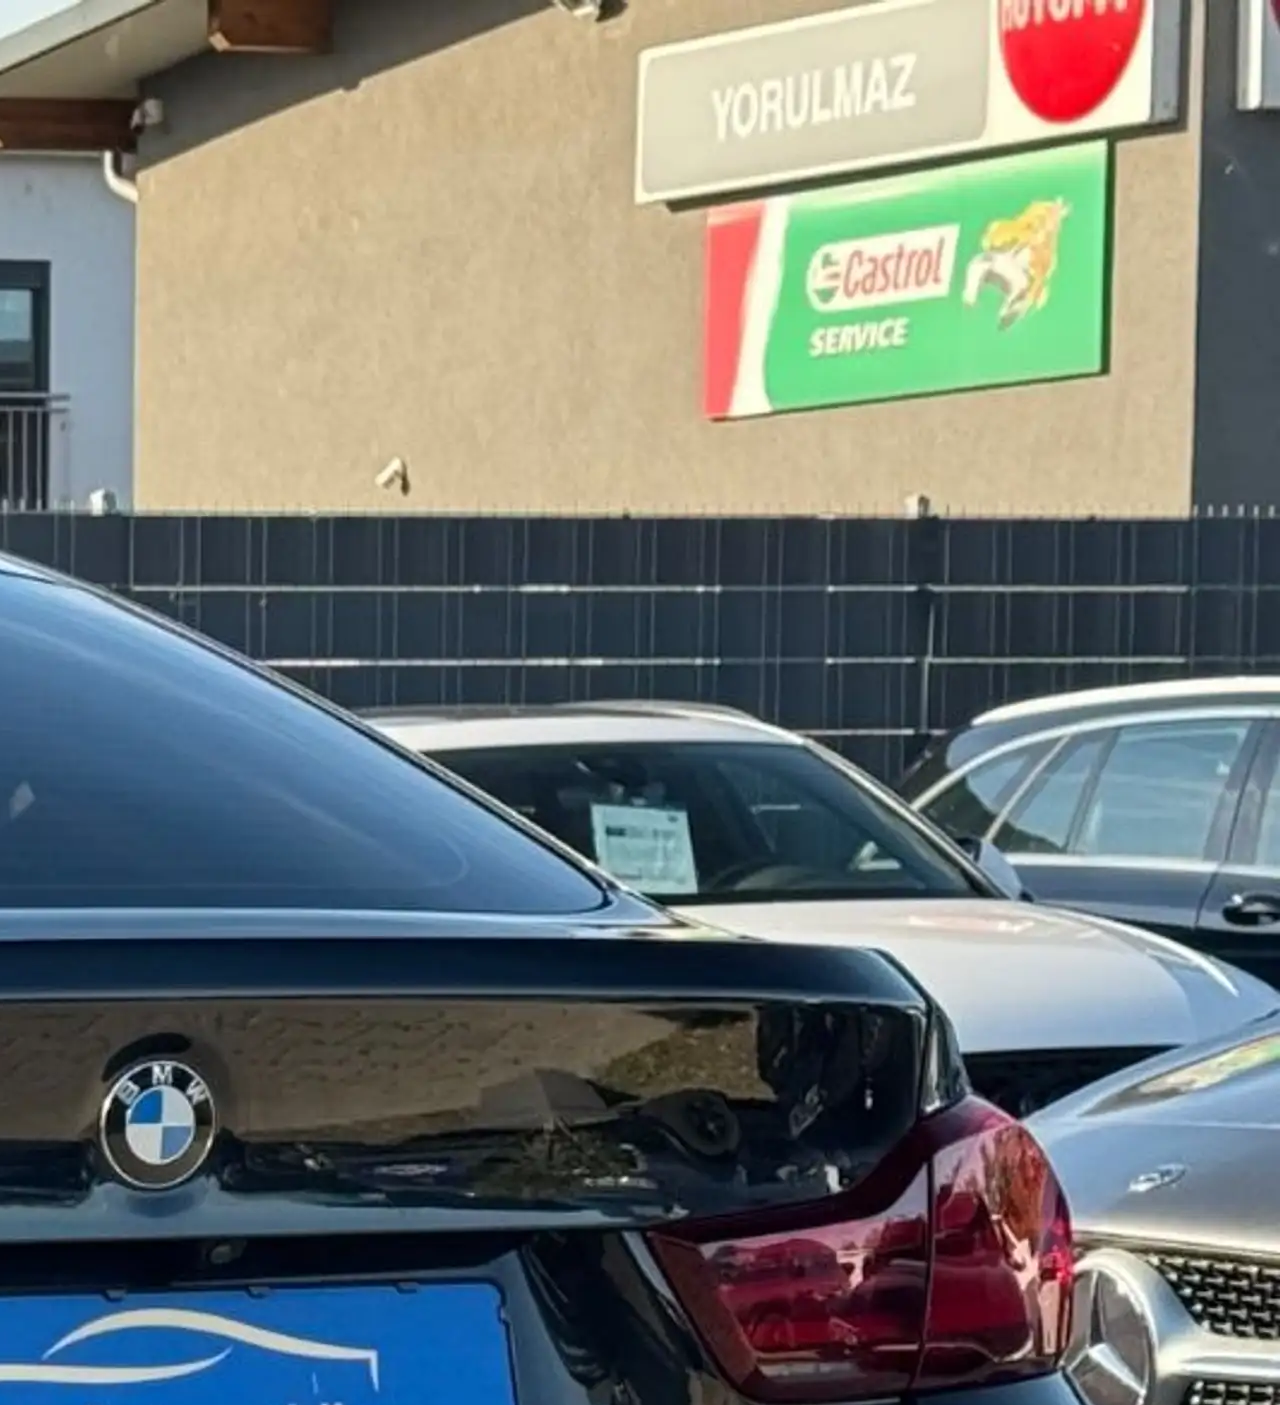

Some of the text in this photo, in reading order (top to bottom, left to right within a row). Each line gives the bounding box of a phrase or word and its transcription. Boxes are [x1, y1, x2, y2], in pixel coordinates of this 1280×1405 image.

[711, 53, 917, 141] YORULMAZ
[843, 237, 945, 298] Castrol
[809, 317, 909, 357] SERVICE
[116, 1064, 207, 1105] BMW
